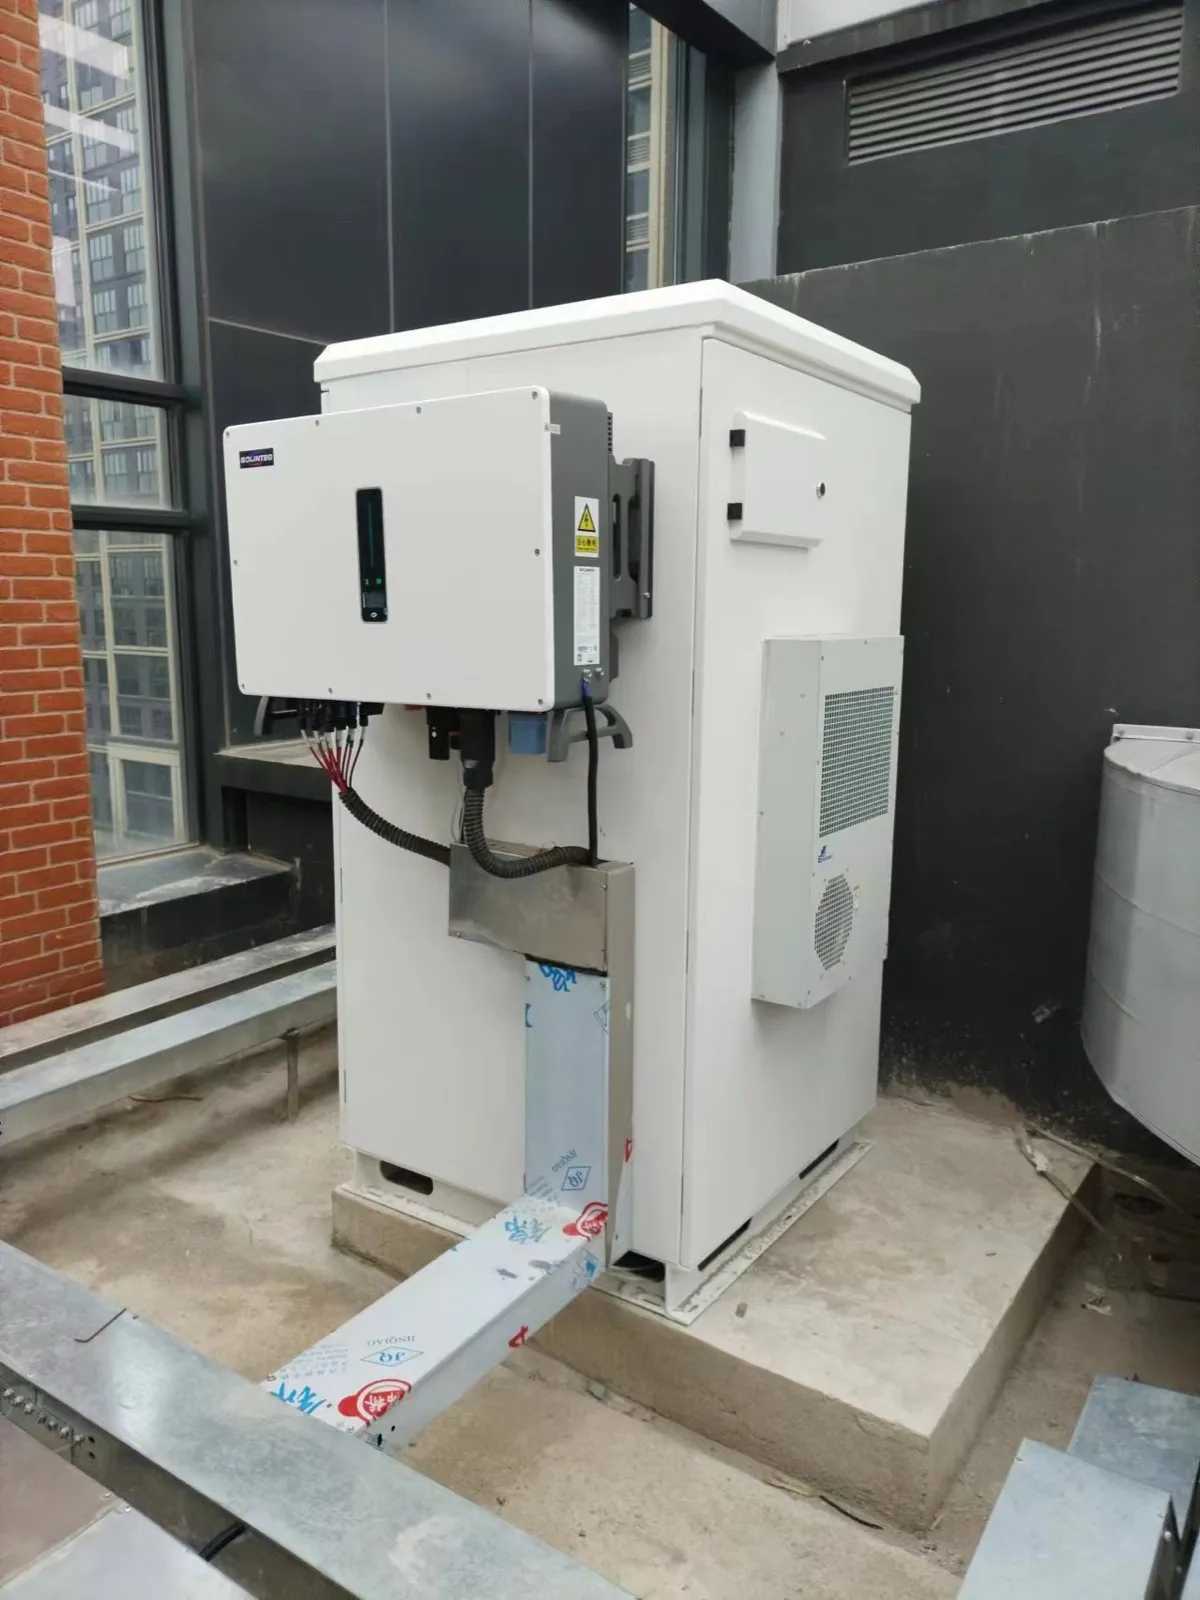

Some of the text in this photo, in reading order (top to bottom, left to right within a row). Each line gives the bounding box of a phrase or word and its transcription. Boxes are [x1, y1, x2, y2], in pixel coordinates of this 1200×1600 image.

[240, 453, 273, 464] SOLINTEG
[567, 1171, 583, 1187] JQ
[367, 1335, 416, 1347] JINQIAO
[379, 1351, 405, 1363] JQ
